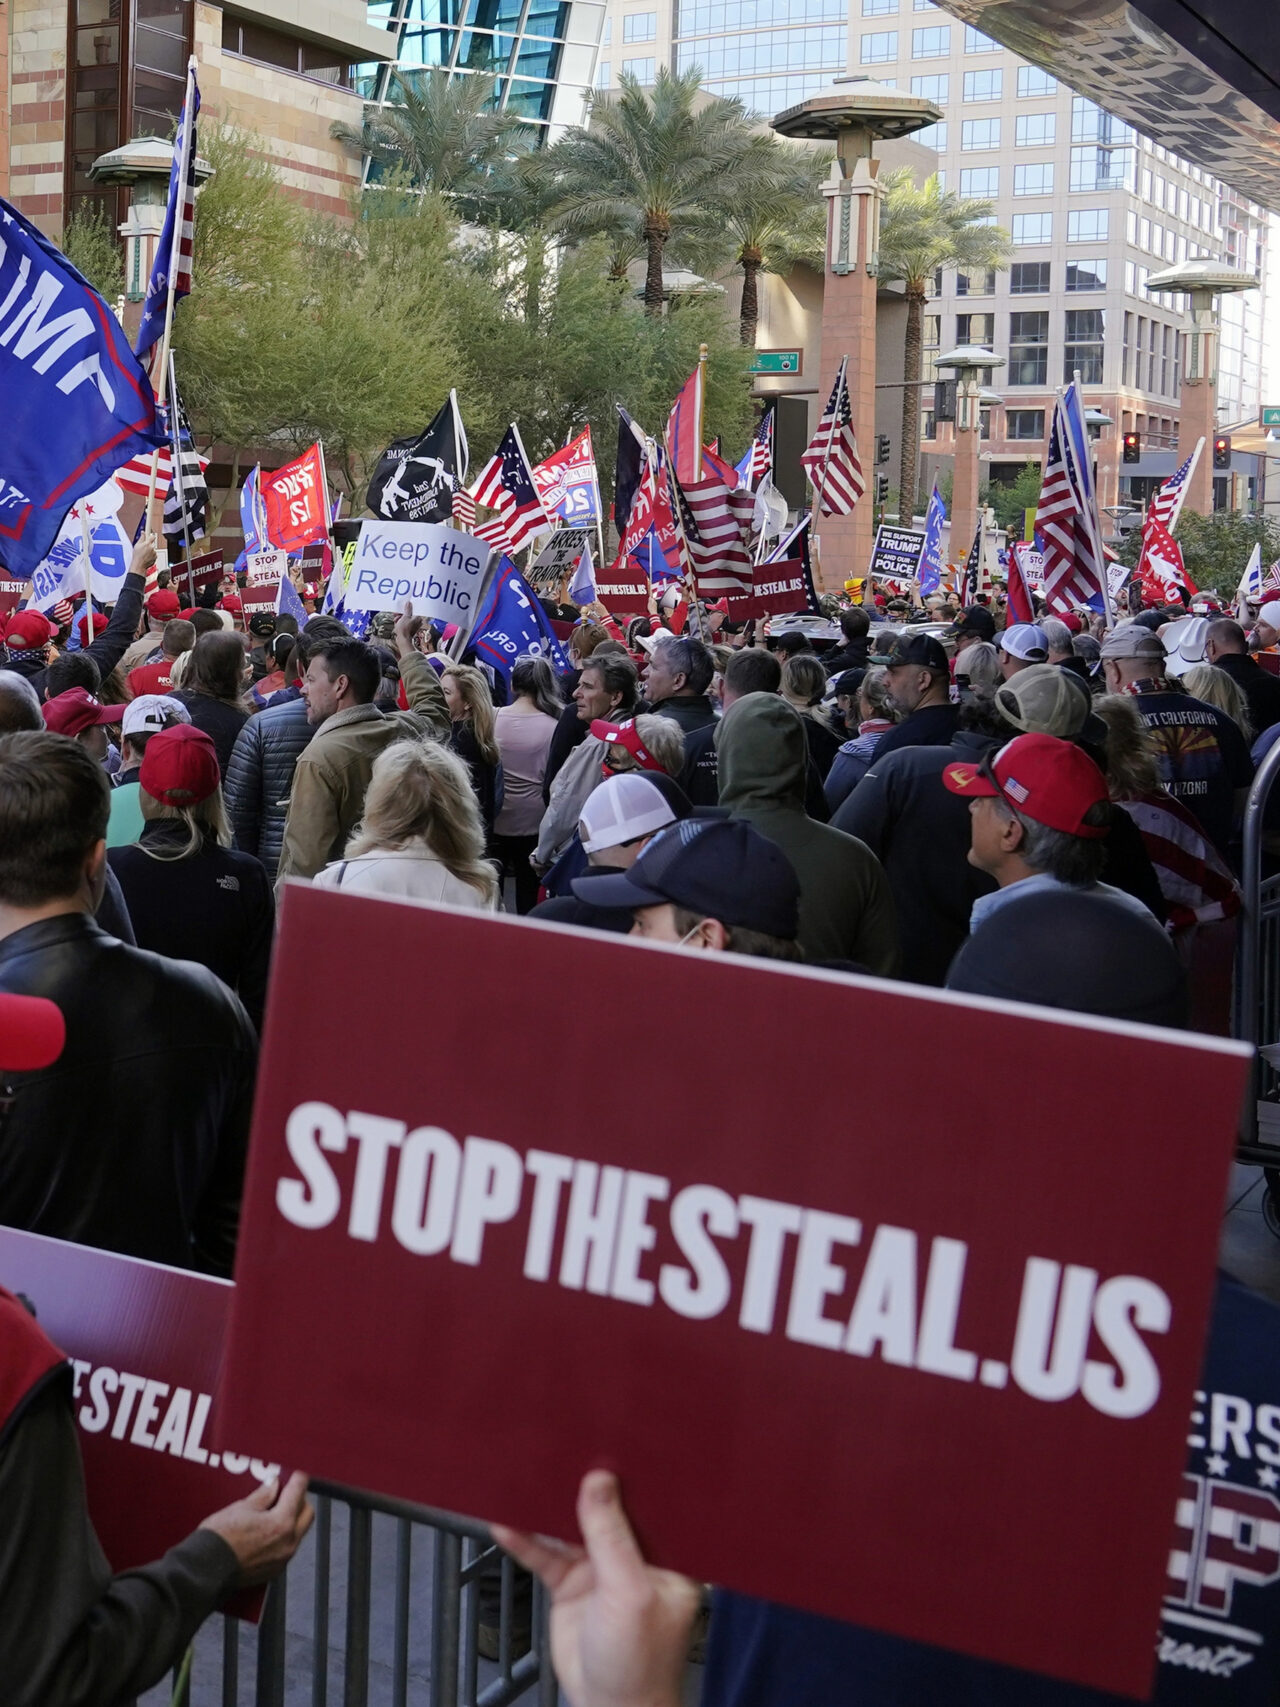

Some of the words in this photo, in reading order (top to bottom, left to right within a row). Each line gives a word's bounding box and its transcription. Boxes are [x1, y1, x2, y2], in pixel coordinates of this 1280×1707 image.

[882, 530, 892, 539] WE
[893, 532, 922, 543] SUPPORT
[880, 538, 921, 554] TRUMP
[254, 556, 278, 566] STOP
[362, 534, 429, 567] Keep
[439, 542, 480, 575] the
[883, 553, 897, 561] AND
[897, 555, 911, 563] OUR
[875, 558, 915, 575] POLICE
[254, 571, 281, 582] STEAL
[355, 569, 470, 610] Republic
[1160, 711, 1218, 726] CALIFORNIA
[276, 1100, 1172, 1419] STOPTHESTEAL.US
